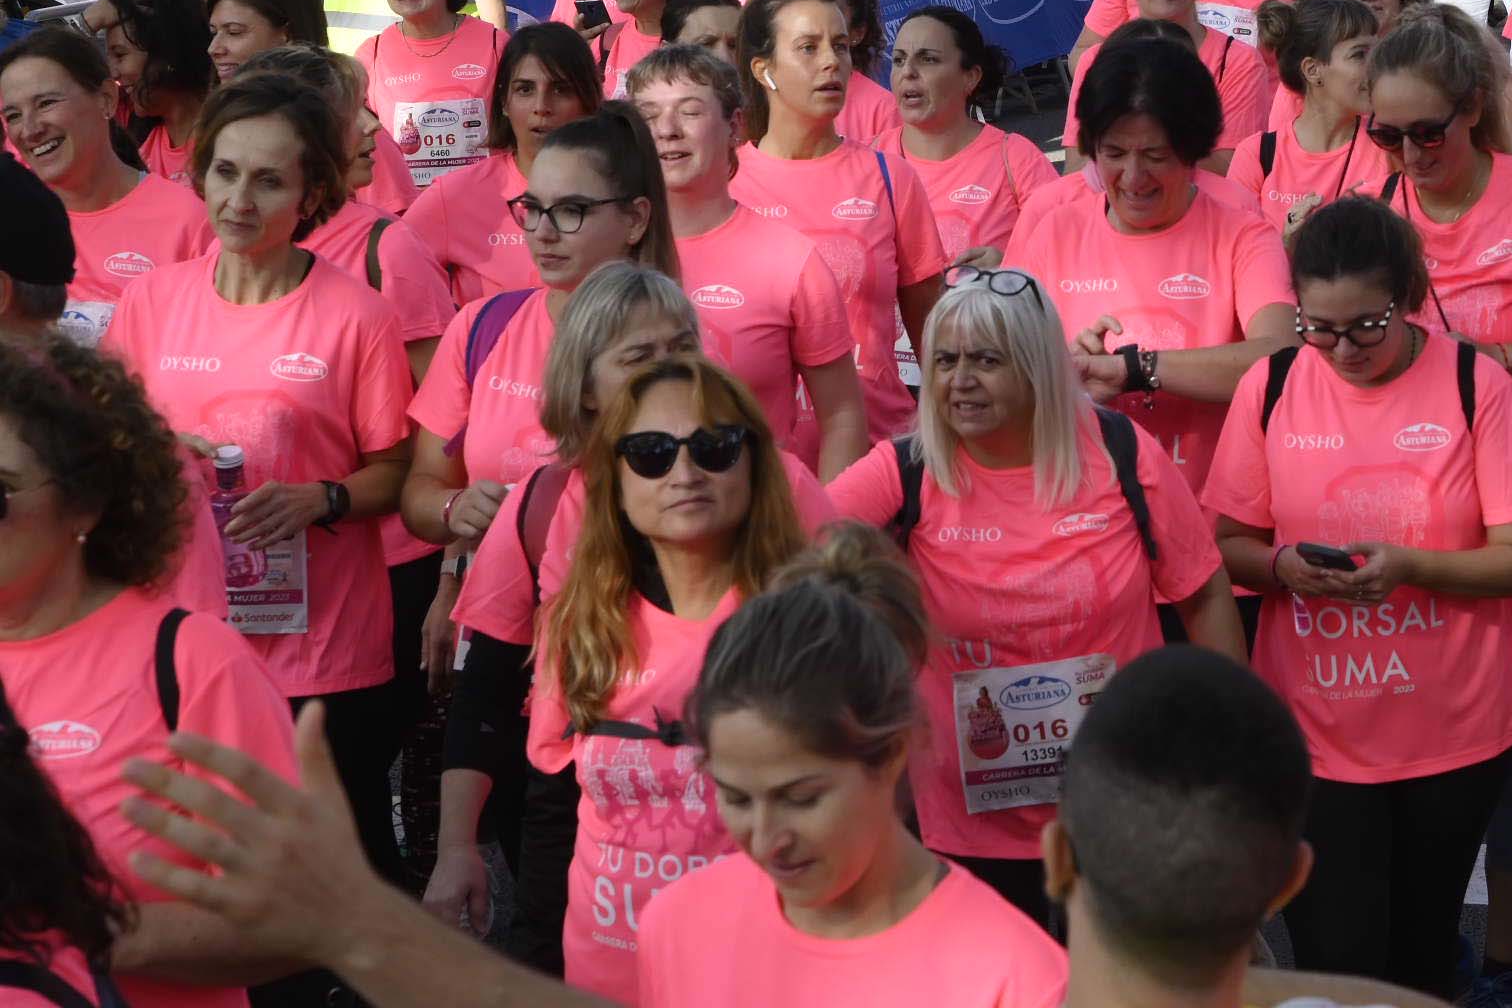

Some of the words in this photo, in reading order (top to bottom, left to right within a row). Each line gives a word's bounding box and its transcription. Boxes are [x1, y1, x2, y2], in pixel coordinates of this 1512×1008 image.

[424, 133, 456, 147] 016
[430, 149, 450, 158] 6460
[408, 159, 430, 168] ARRERA
[413, 172, 431, 180] SHO
[1060, 278, 1118, 293] OYSHO
[159, 355, 221, 373] OYSHO
[1284, 432, 1344, 451] OYSHO
[938, 526, 1002, 544] OYSHO
[244, 612, 295, 623] Santander
[1311, 648, 1410, 688] UMA
[1005, 688, 1067, 705] ASTURIANA
[1012, 719, 1069, 744] 016
[980, 785, 1031, 802] OYSHO
